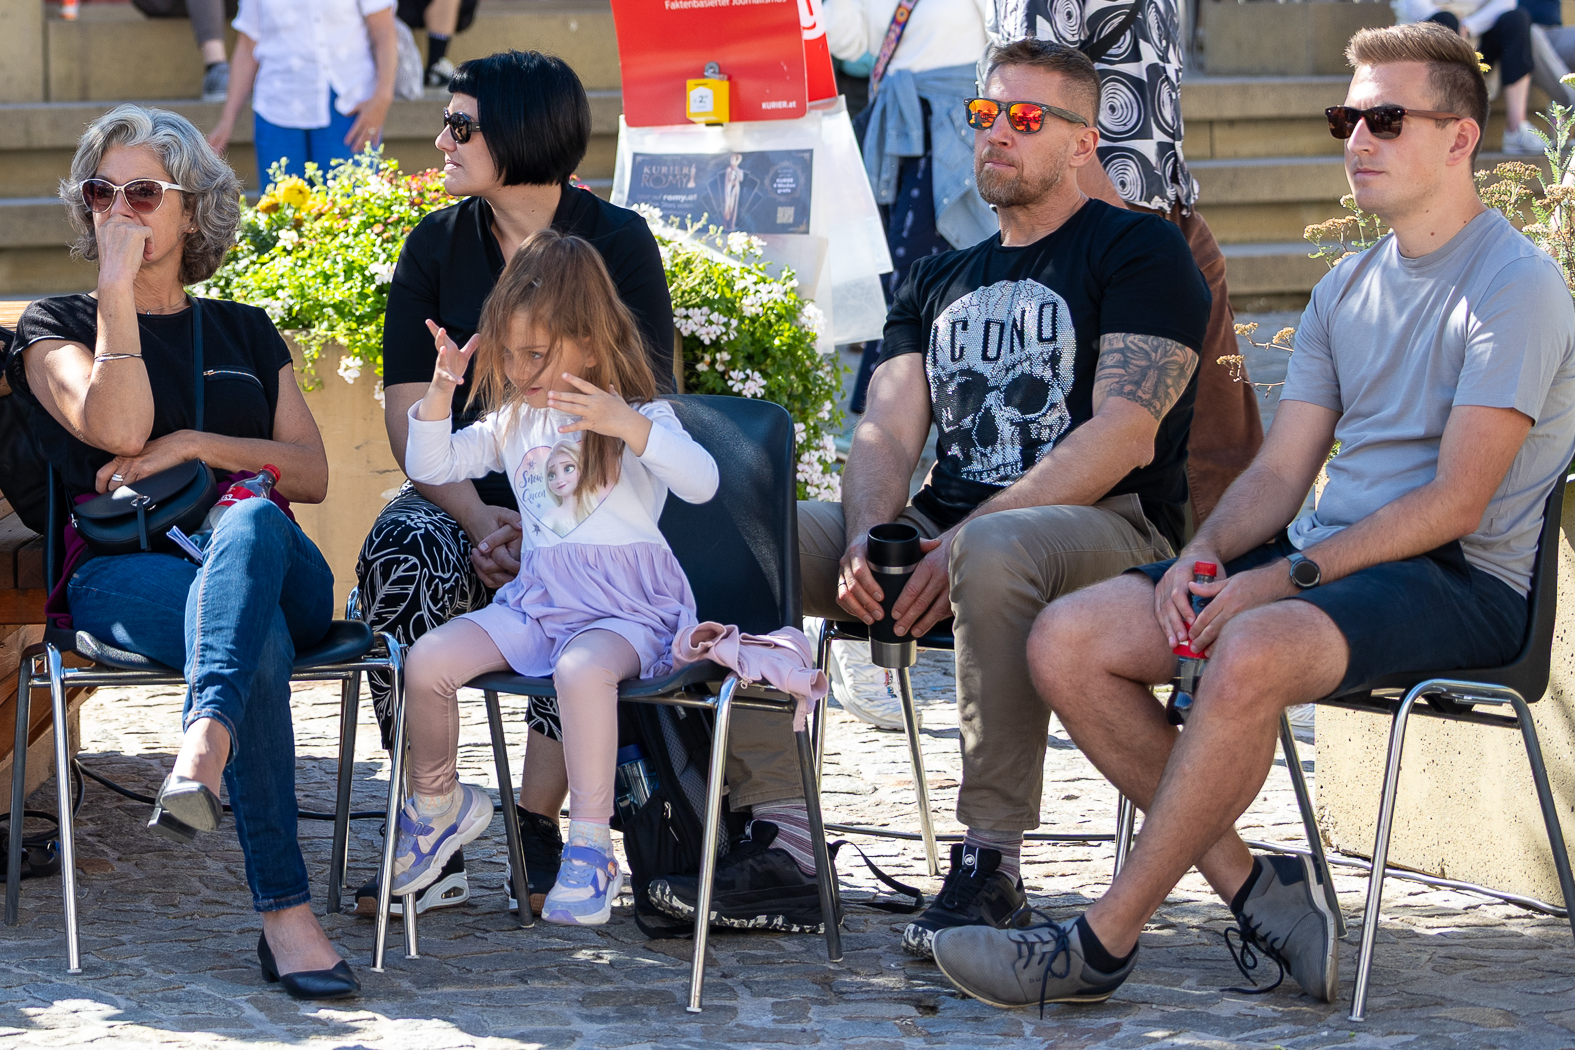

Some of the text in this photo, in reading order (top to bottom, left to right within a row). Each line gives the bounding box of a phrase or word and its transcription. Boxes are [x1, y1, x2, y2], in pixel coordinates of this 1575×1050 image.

[761, 101, 797, 110] KURIER.at
[643, 165, 689, 174] KURIER
[663, 193, 698, 203] romy.at
[932, 302, 1058, 366] ICONO
[519, 470, 543, 488] Snow
[522, 489, 545, 504] Queen
